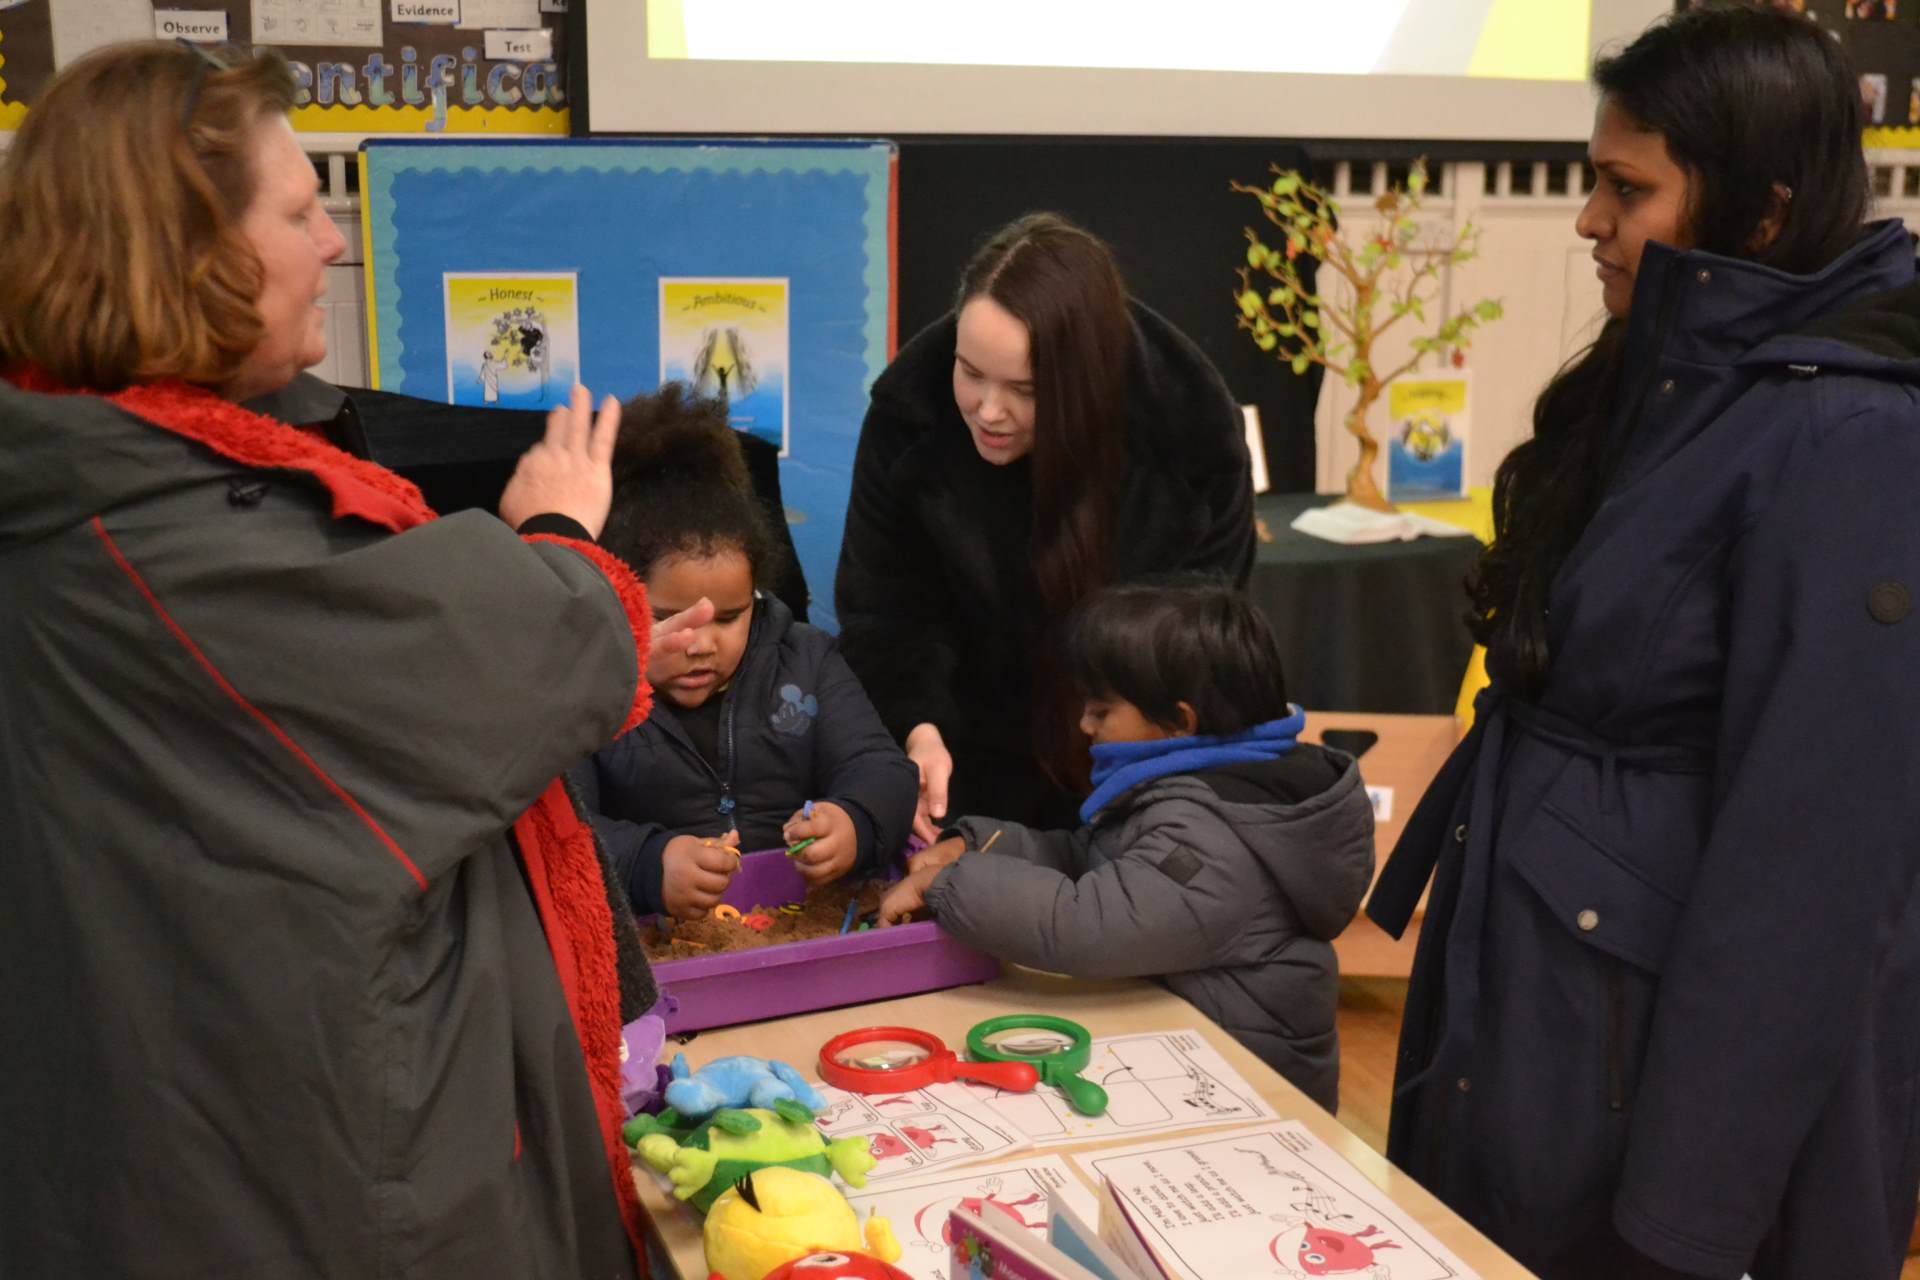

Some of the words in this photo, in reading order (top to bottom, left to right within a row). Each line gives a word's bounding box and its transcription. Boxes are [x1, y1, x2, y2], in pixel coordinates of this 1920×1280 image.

[397, 3, 454, 17] Evidence
[163, 21, 221, 34] Observe
[504, 40, 532, 53] Test
[253, 46, 565, 132] entifica
[489, 287, 534, 301] Honest
